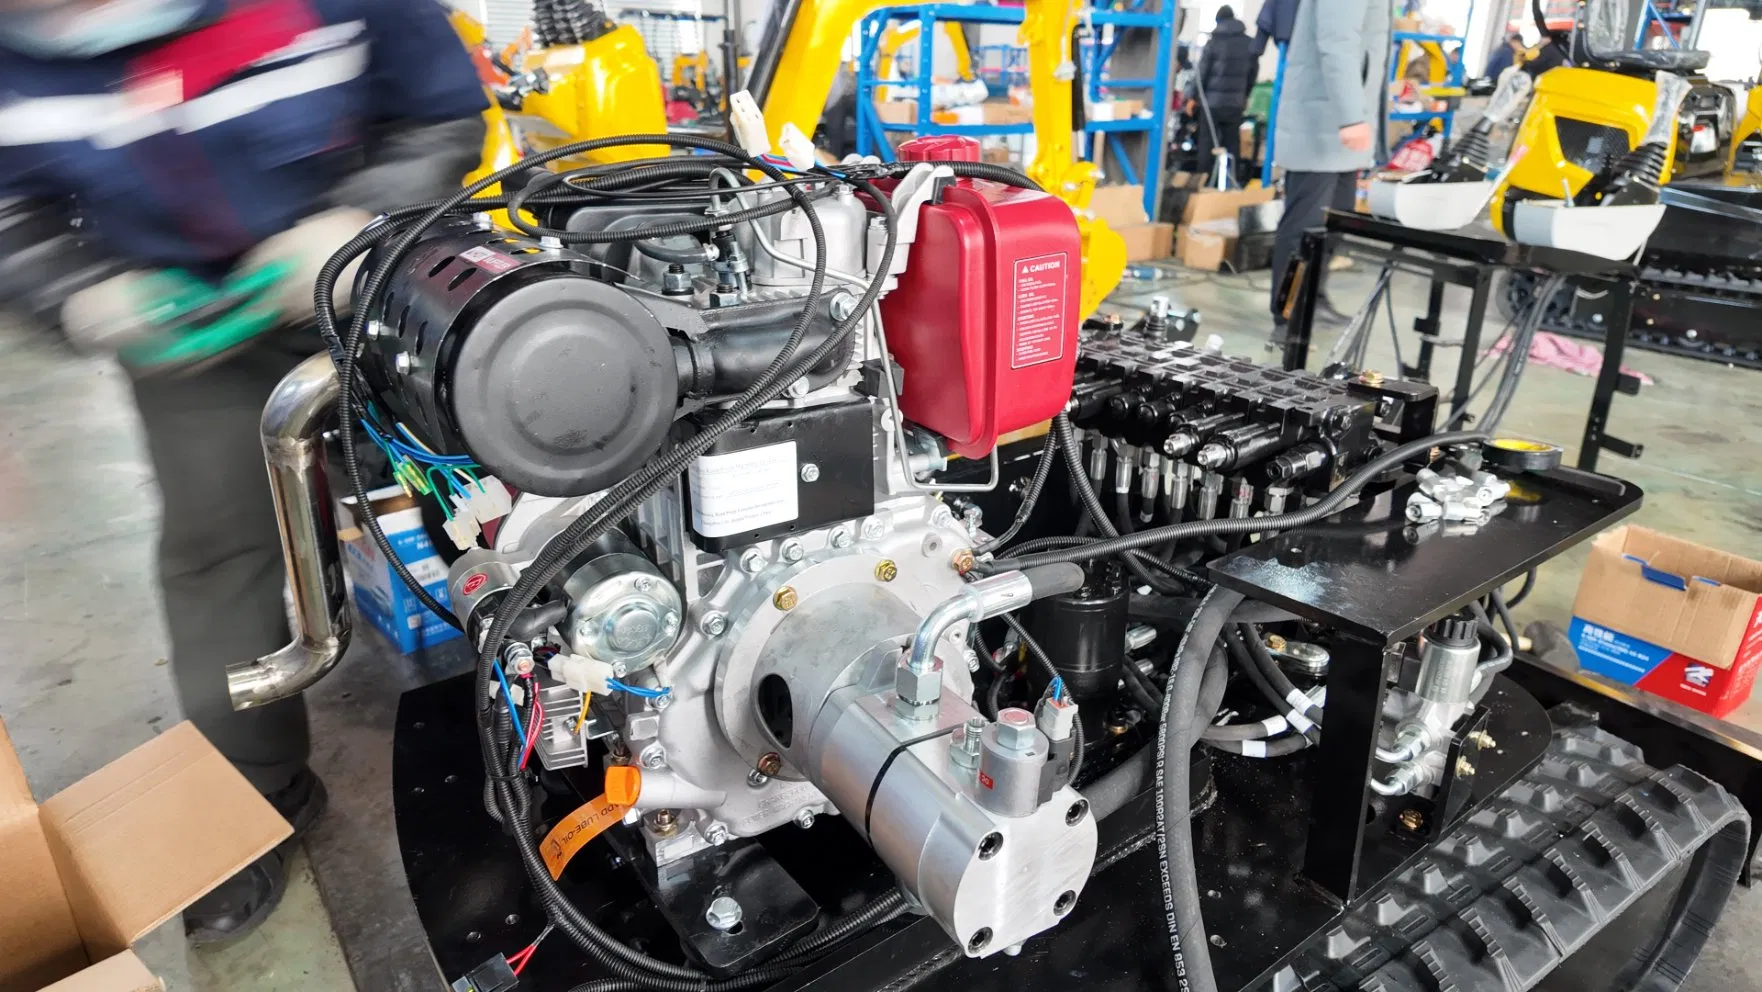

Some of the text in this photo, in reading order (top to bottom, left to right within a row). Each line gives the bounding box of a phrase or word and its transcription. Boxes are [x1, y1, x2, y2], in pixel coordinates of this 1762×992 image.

[1030, 261, 1060, 272] CAUTION
[1155, 769, 1164, 788] SAE
[562, 813, 600, 844] LUBE-OIL
[1160, 860, 1174, 911] EXCEEDS
[1166, 912, 1177, 933] DIN
[1170, 935, 1181, 951] EN
[1173, 953, 1186, 977] 853
